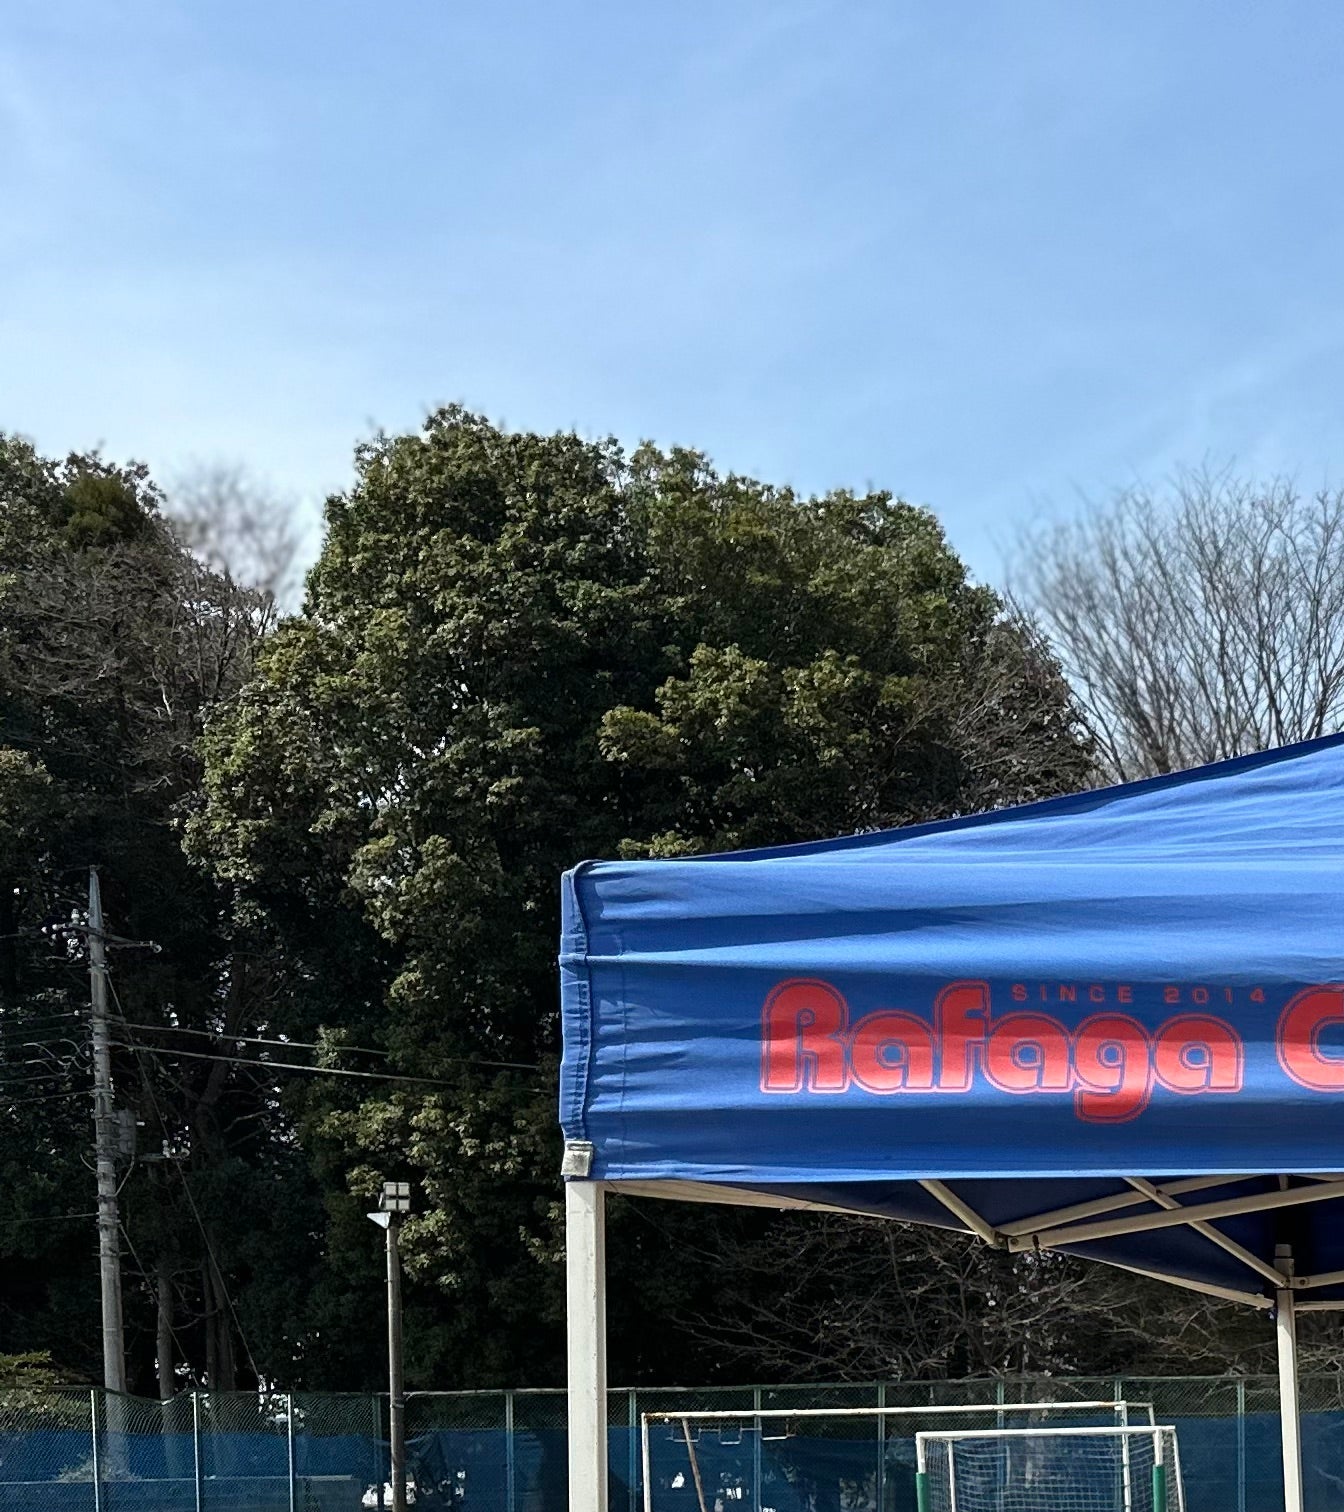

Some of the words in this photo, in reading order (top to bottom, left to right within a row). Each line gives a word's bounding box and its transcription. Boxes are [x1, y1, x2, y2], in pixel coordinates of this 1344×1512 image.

[1011, 983, 1133, 1004] SINCE
[1163, 985, 1265, 1004] 2014
[760, 978, 1244, 1123] Rafaga
